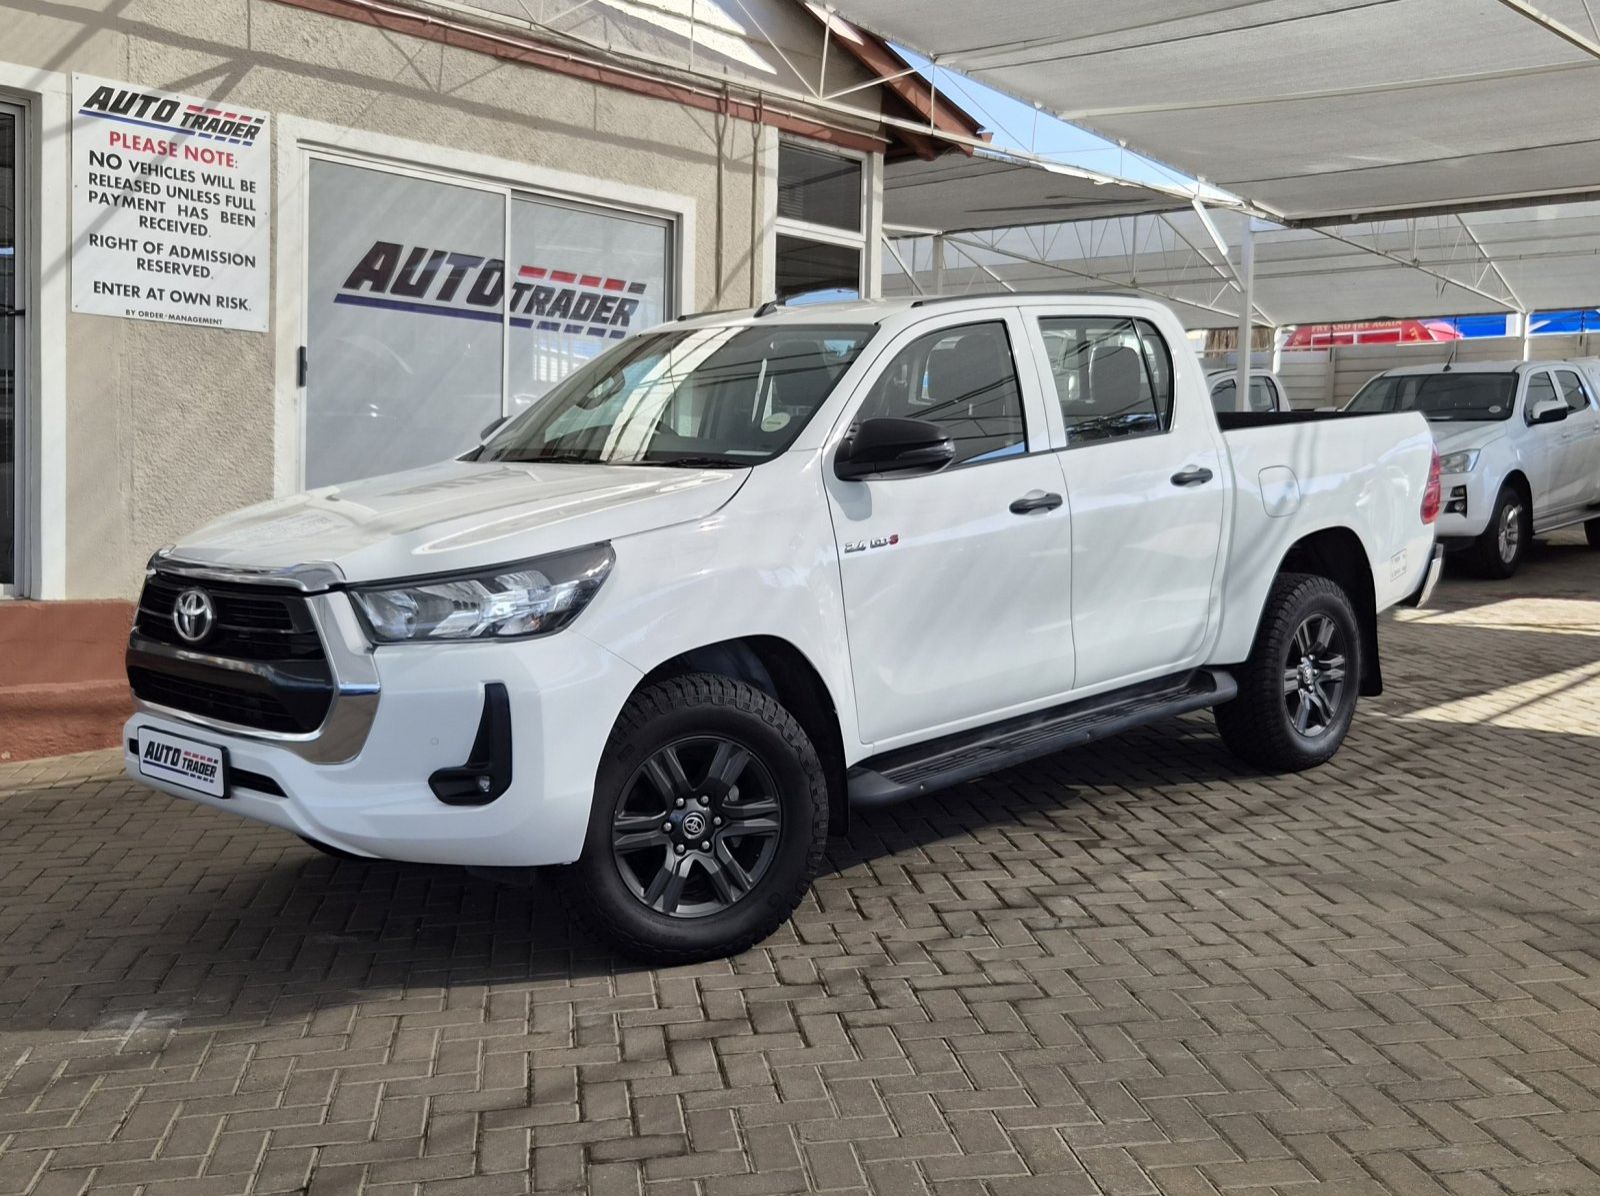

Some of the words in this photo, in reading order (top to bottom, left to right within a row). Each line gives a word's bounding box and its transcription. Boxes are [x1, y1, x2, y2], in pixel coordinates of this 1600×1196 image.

[83, 86, 181, 122] AUTO
[179, 112, 261, 140] TRADER
[109, 131, 177, 157] PLEASE
[184, 145, 238, 169] NOTE:
[89, 150, 122, 170] NO
[129, 160, 195, 183] VEHICLES
[201, 173, 235, 190] WILL
[240, 180, 256, 193] BE
[89, 172, 161, 195] RELEASED
[166, 185, 220, 205] UNLESS
[225, 195, 256, 211] FULL
[89, 190, 166, 214] PAYMENT
[177, 204, 209, 220] HAS
[220, 211, 256, 228] BEEN
[139, 215, 211, 238] RECEIVED.
[89, 233, 138, 252] RIGHT
[143, 241, 164, 255] OF
[168, 245, 256, 268] ADMISSION
[136, 258, 214, 280] RESERVED.
[93, 281, 141, 300] ENTER
[146, 287, 165, 302] AT
[169, 290, 211, 307] OWN
[216, 295, 252, 312] RISK.
[342, 241, 504, 307] AUTO
[509, 282, 639, 327] TRADER
[125, 309, 136, 317] BY
[138, 310, 164, 320] ORDER
[144, 741, 182, 767] AUTO
[182, 757, 217, 778] TRADER
